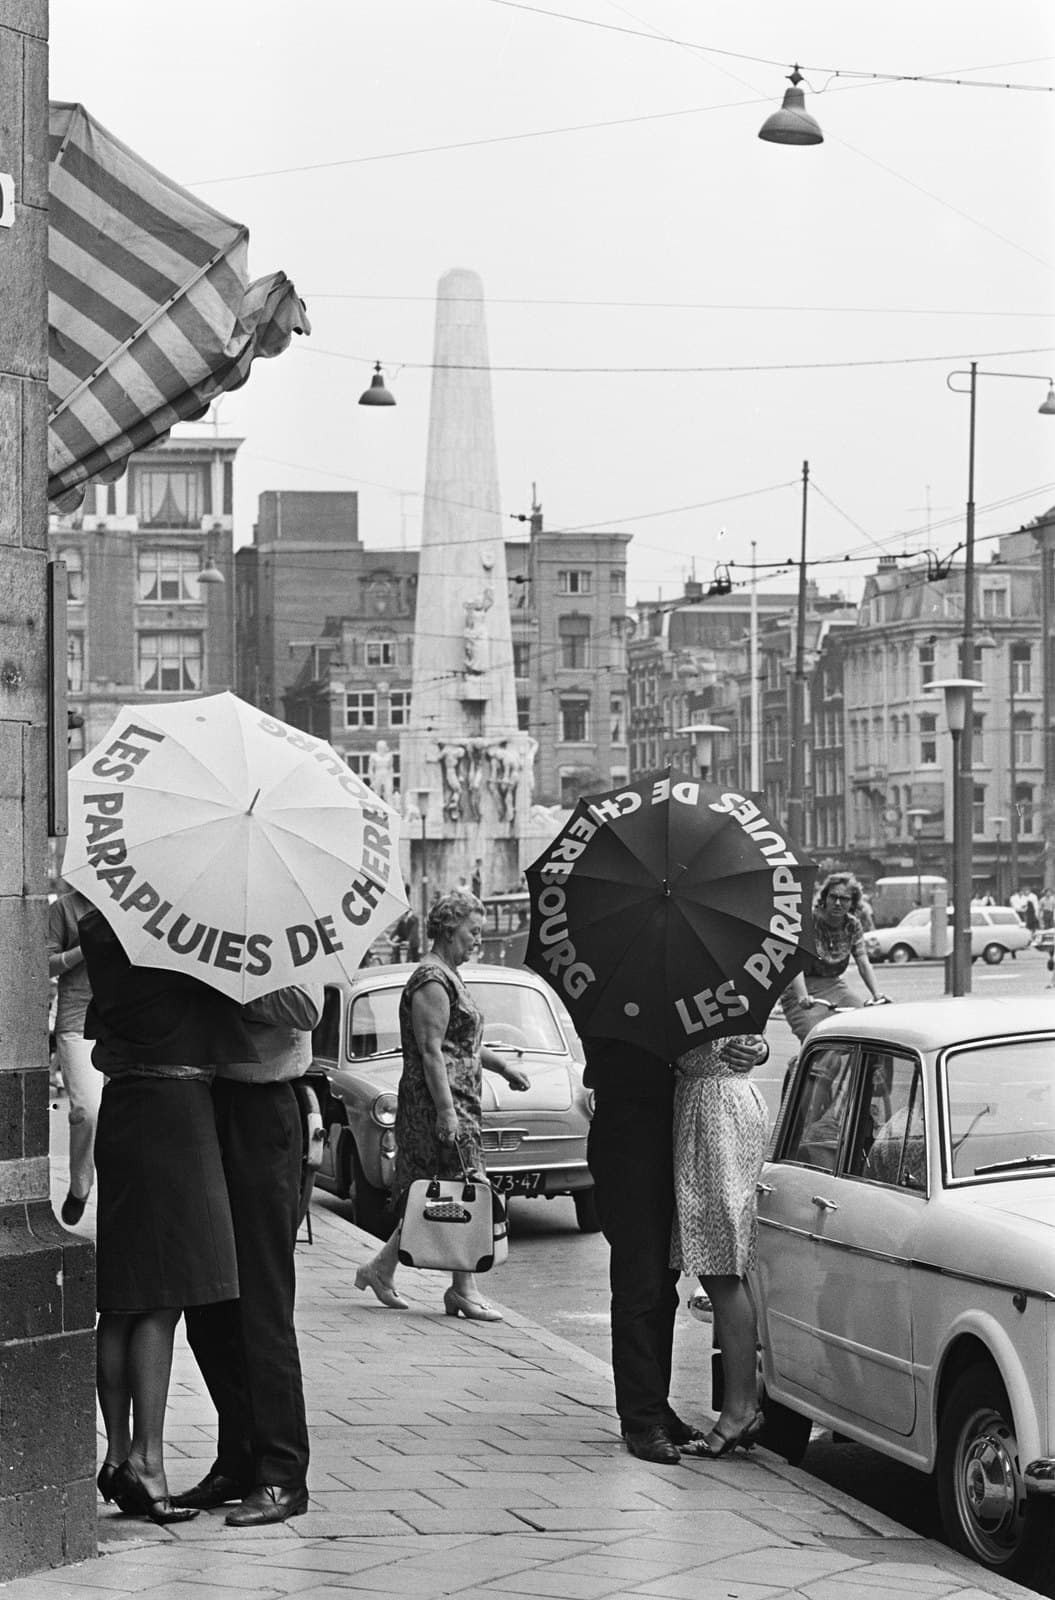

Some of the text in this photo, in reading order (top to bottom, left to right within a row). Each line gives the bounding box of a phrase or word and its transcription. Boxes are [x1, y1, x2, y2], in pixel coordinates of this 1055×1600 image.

[83, 717, 393, 977] LES PARAPLUIES DE CHERBOURG
[537, 778, 803, 1036] LES PARAPLUIES DE CHERBOURG
